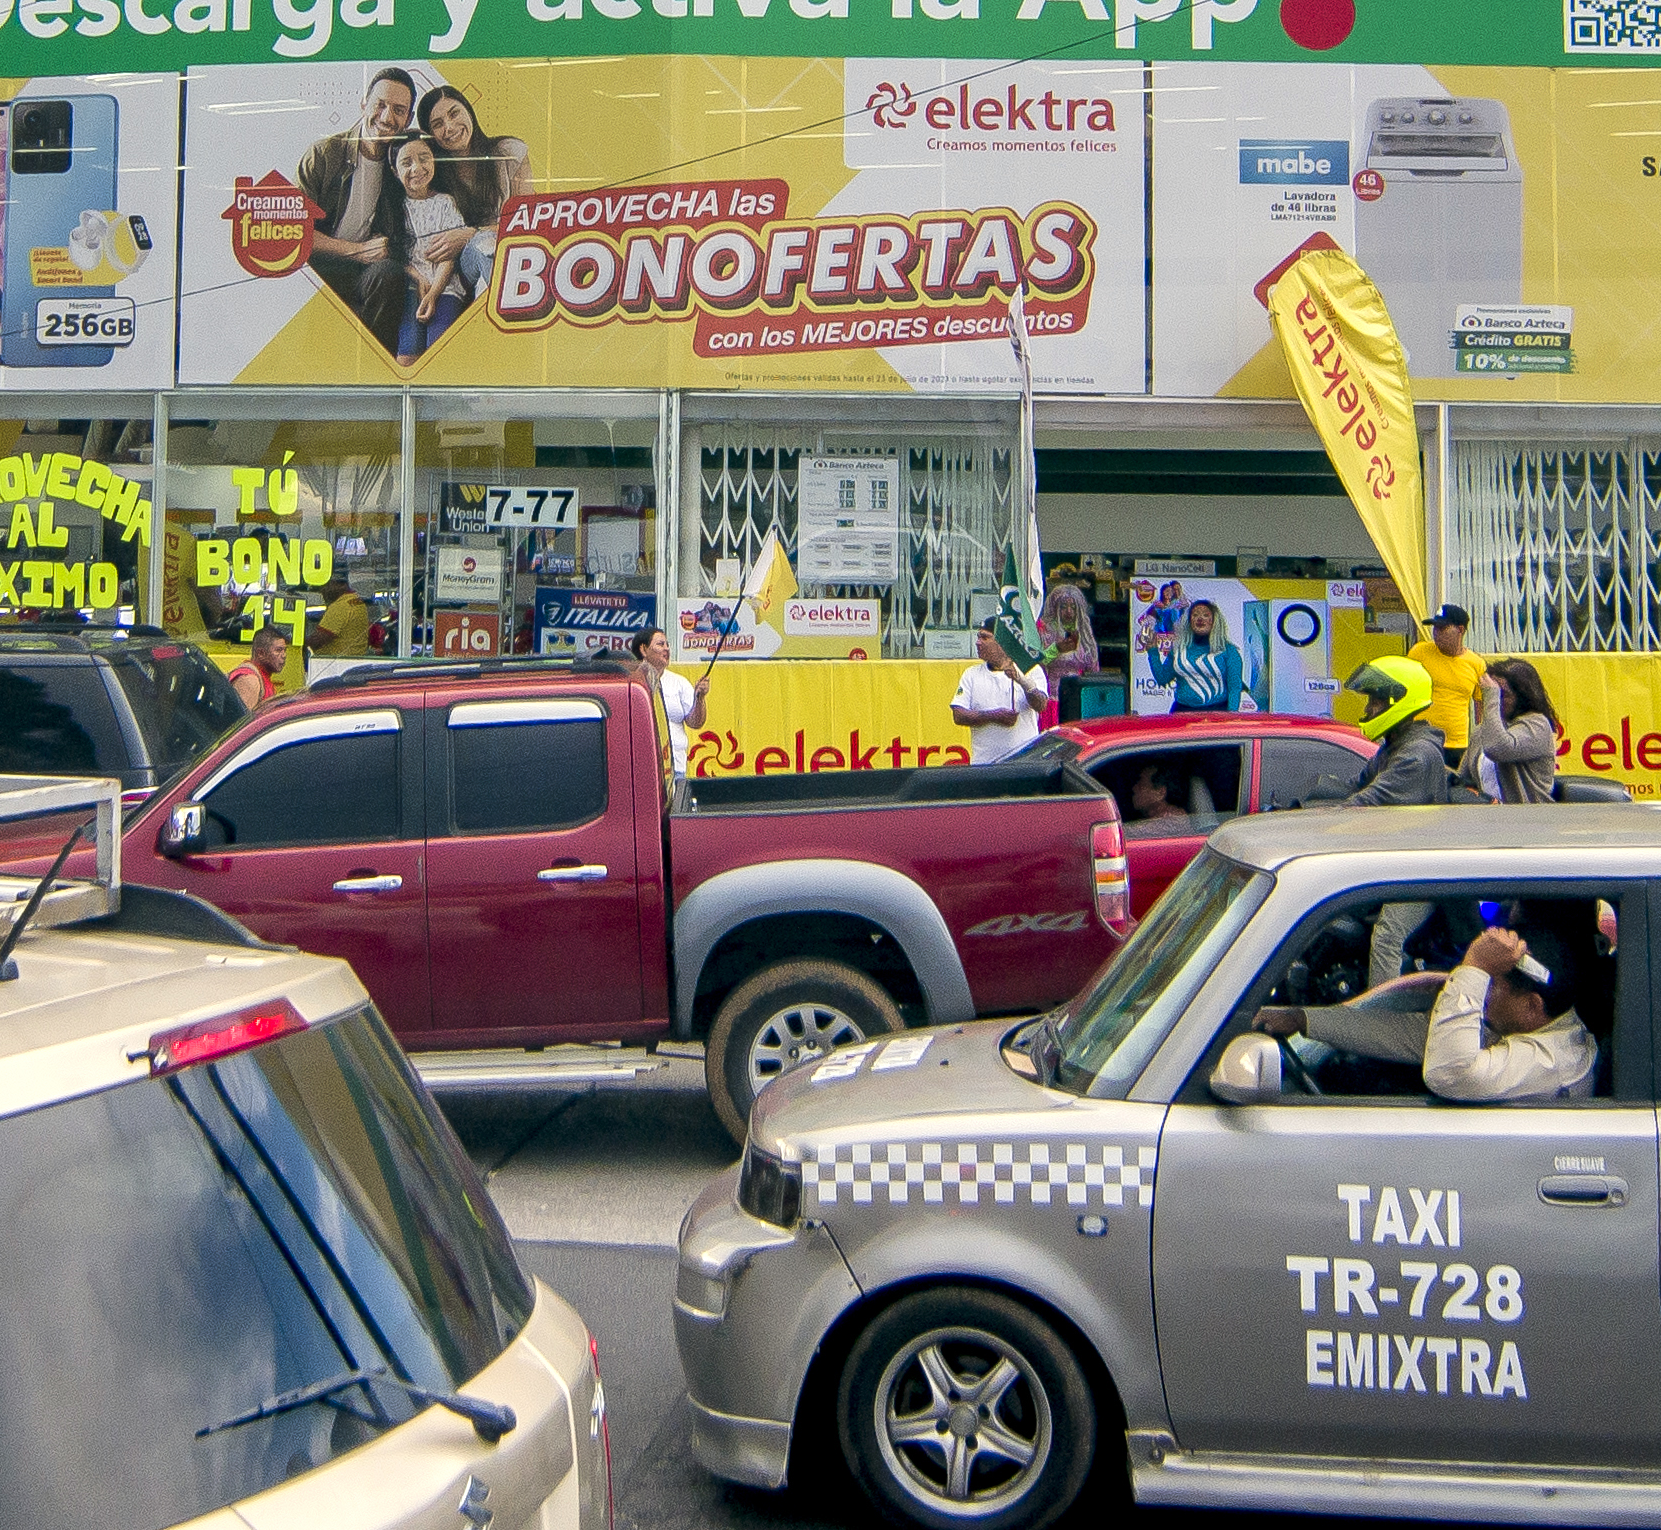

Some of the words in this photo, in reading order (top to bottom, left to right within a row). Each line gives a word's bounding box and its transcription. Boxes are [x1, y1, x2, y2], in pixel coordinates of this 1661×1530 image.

[924, 83, 1117, 132] elektra
[926, 137, 988, 154] Creamos
[991, 138, 1066, 154] momentos
[1069, 138, 1118, 154] felices
[1257, 151, 1332, 175] mabe
[1283, 190, 1337, 202] Lavadora
[1358, 173, 1376, 186] 46
[236, 192, 305, 211] Creamos
[252, 207, 309, 220] momentos
[505, 189, 720, 233] APROVECHA
[728, 187, 776, 216] las
[1270, 202, 1285, 213] de
[1287, 202, 1302, 213] 46
[1304, 202, 1337, 213] libras
[239, 213, 304, 248] felices
[498, 210, 1080, 316] BONOFERTAS
[44, 314, 134, 338] 256GB
[707, 329, 755, 351] con
[759, 324, 796, 348] los
[800, 317, 928, 346] MEJORES
[933, 307, 1074, 337] descuntos
[1464, 333, 1512, 347] Crédito
[1513, 334, 1562, 347] GRATIS
[1484, 317, 1522, 329] Banco
[1525, 317, 1566, 331] Azteca
[1295, 292, 1377, 451] elektra
[1464, 353, 1507, 370] 10%
[232, 450, 299, 517] TÚ
[488, 489, 575, 524] 7-77
[7, 501, 70, 549] AL
[196, 537, 334, 588] BONO
[442, 573, 496, 590] MoneyGram
[239, 594, 307, 648] 14
[563, 607, 651, 629] ITALIKA
[807, 604, 871, 622] elektra
[444, 615, 491, 652] ria
[754, 727, 971, 778] elektra
[1337, 1183, 1463, 1248] TAXI
[1285, 1254, 1525, 1322] TR-728
[1305, 1329, 1529, 1399] EMIXTRA
